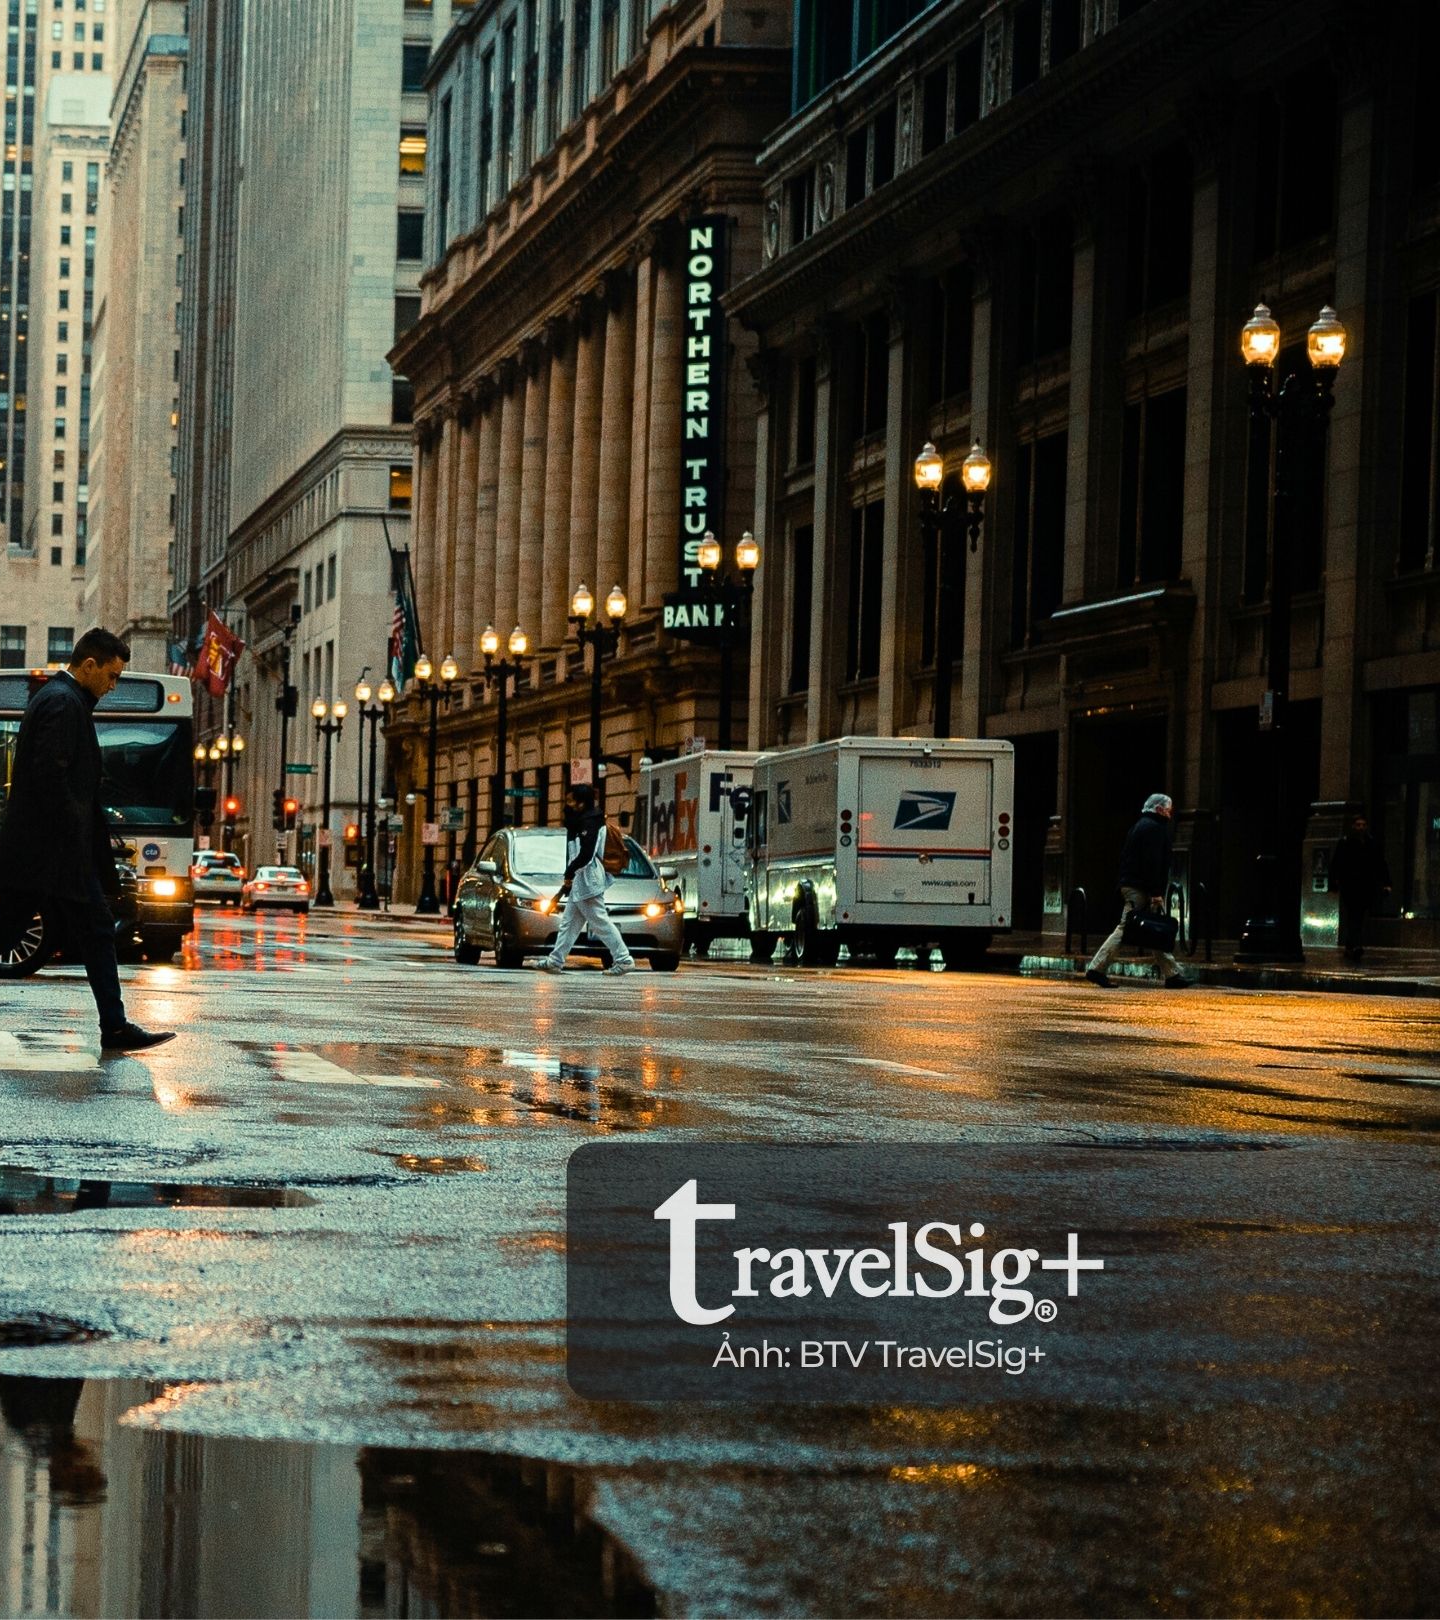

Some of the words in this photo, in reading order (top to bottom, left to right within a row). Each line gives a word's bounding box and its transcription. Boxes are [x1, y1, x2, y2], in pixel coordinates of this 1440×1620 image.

[687, 226, 713, 439] NORTHERN
[684, 459, 707, 588] TRUST
[650, 771, 699, 857] FedEx
[709, 771, 754, 813] Fe
